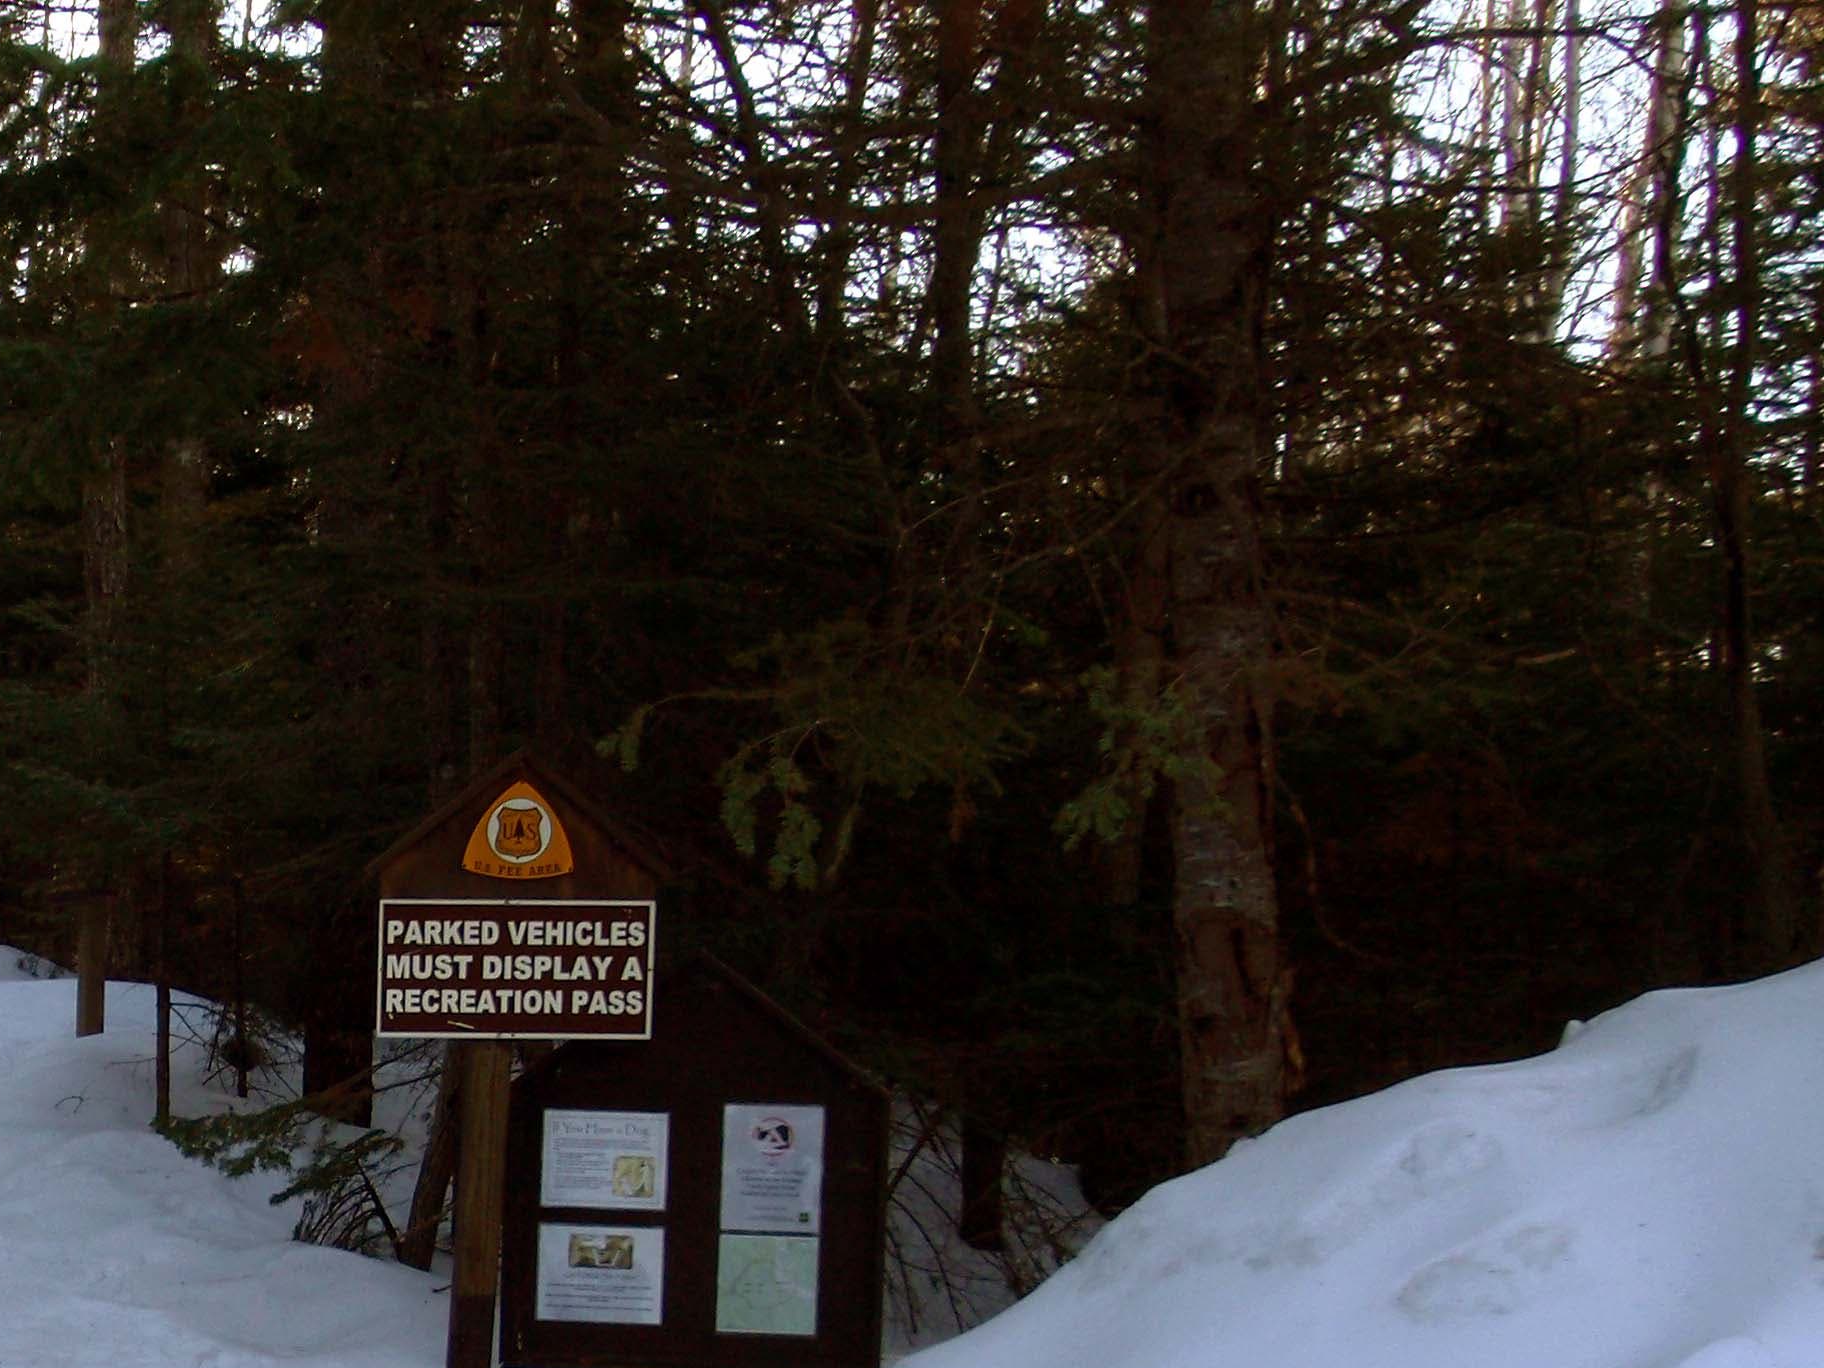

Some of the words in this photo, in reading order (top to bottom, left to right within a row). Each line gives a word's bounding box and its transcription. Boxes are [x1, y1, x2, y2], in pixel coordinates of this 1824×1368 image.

[386, 920, 500, 945] PARKED
[508, 921, 646, 947] VEHICLES
[385, 954, 473, 980] MUST
[482, 955, 613, 981] DISPLAY
[621, 956, 643, 981] A
[385, 988, 563, 1015] RECREATION
[571, 990, 643, 1015] PASS
